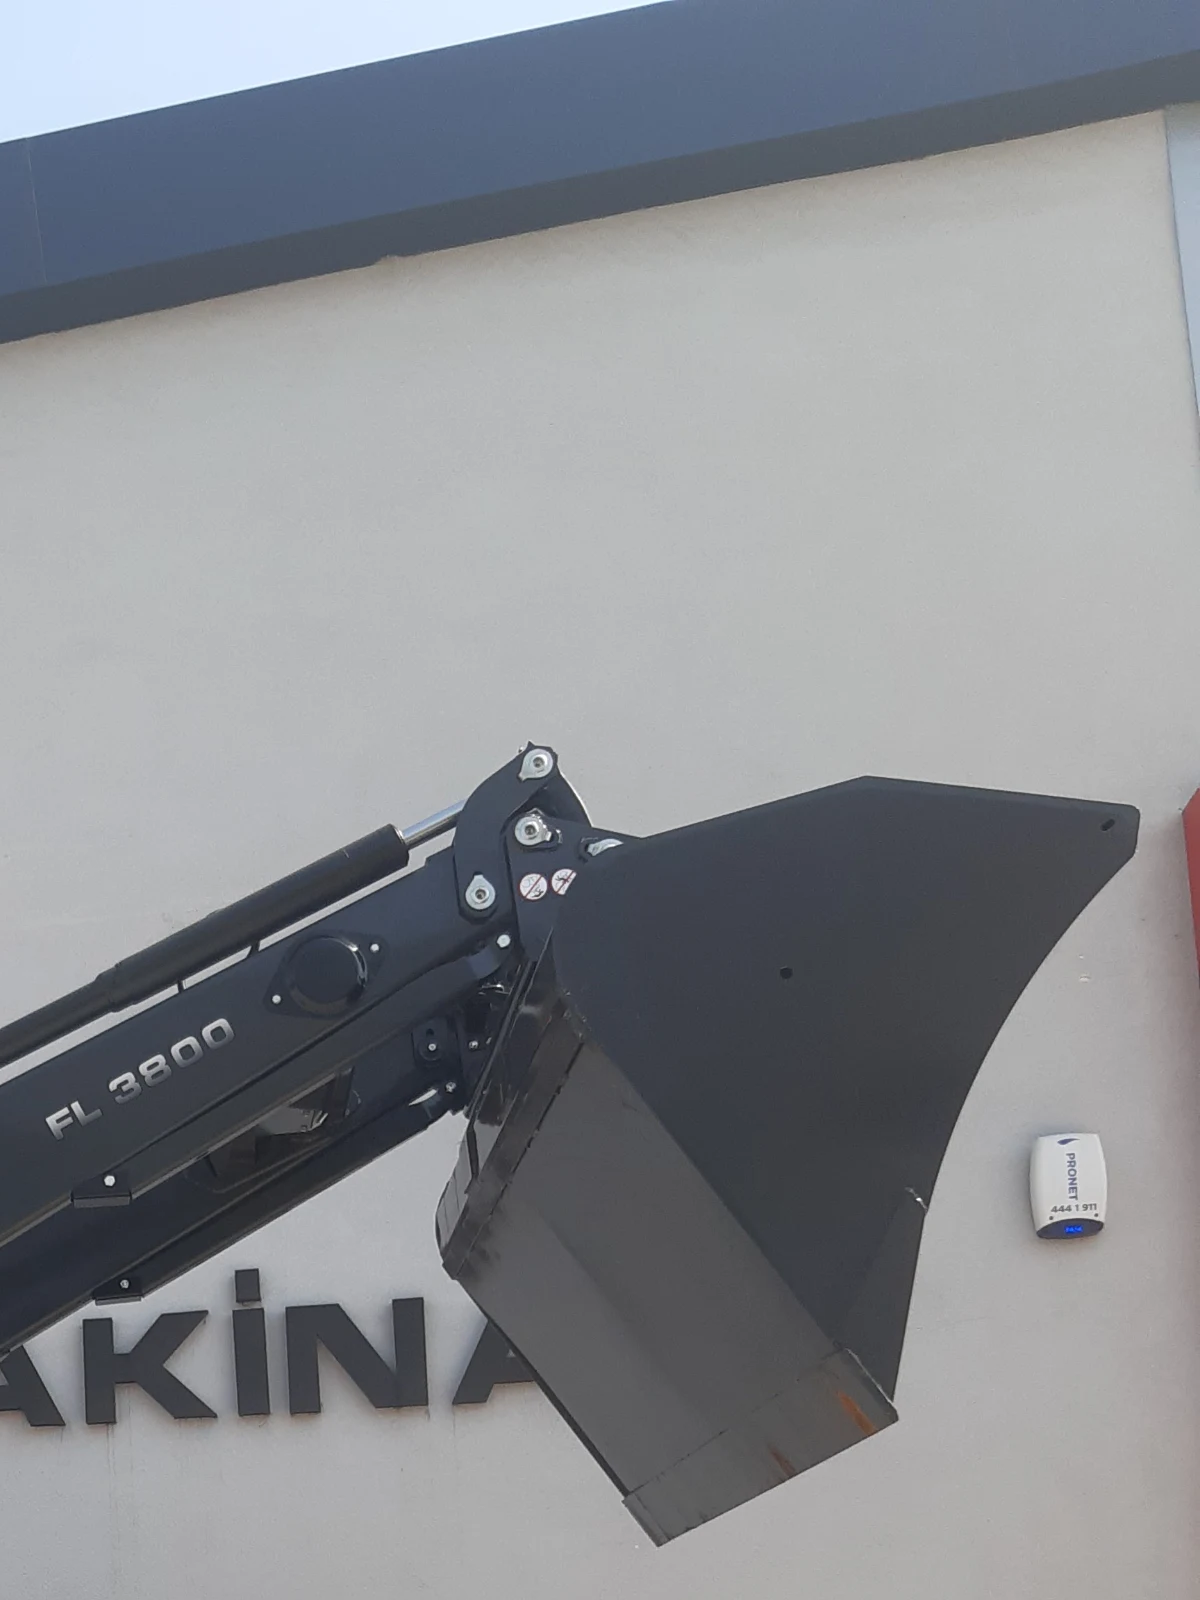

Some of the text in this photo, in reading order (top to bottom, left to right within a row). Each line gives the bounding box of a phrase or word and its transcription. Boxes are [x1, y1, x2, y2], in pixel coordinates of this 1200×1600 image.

[45, 1018, 235, 1140] FL 3800
[1066, 1153, 1078, 1200] PRONET
[1051, 1204, 1072, 1213] 444
[1082, 1203, 1097, 1212] 911
